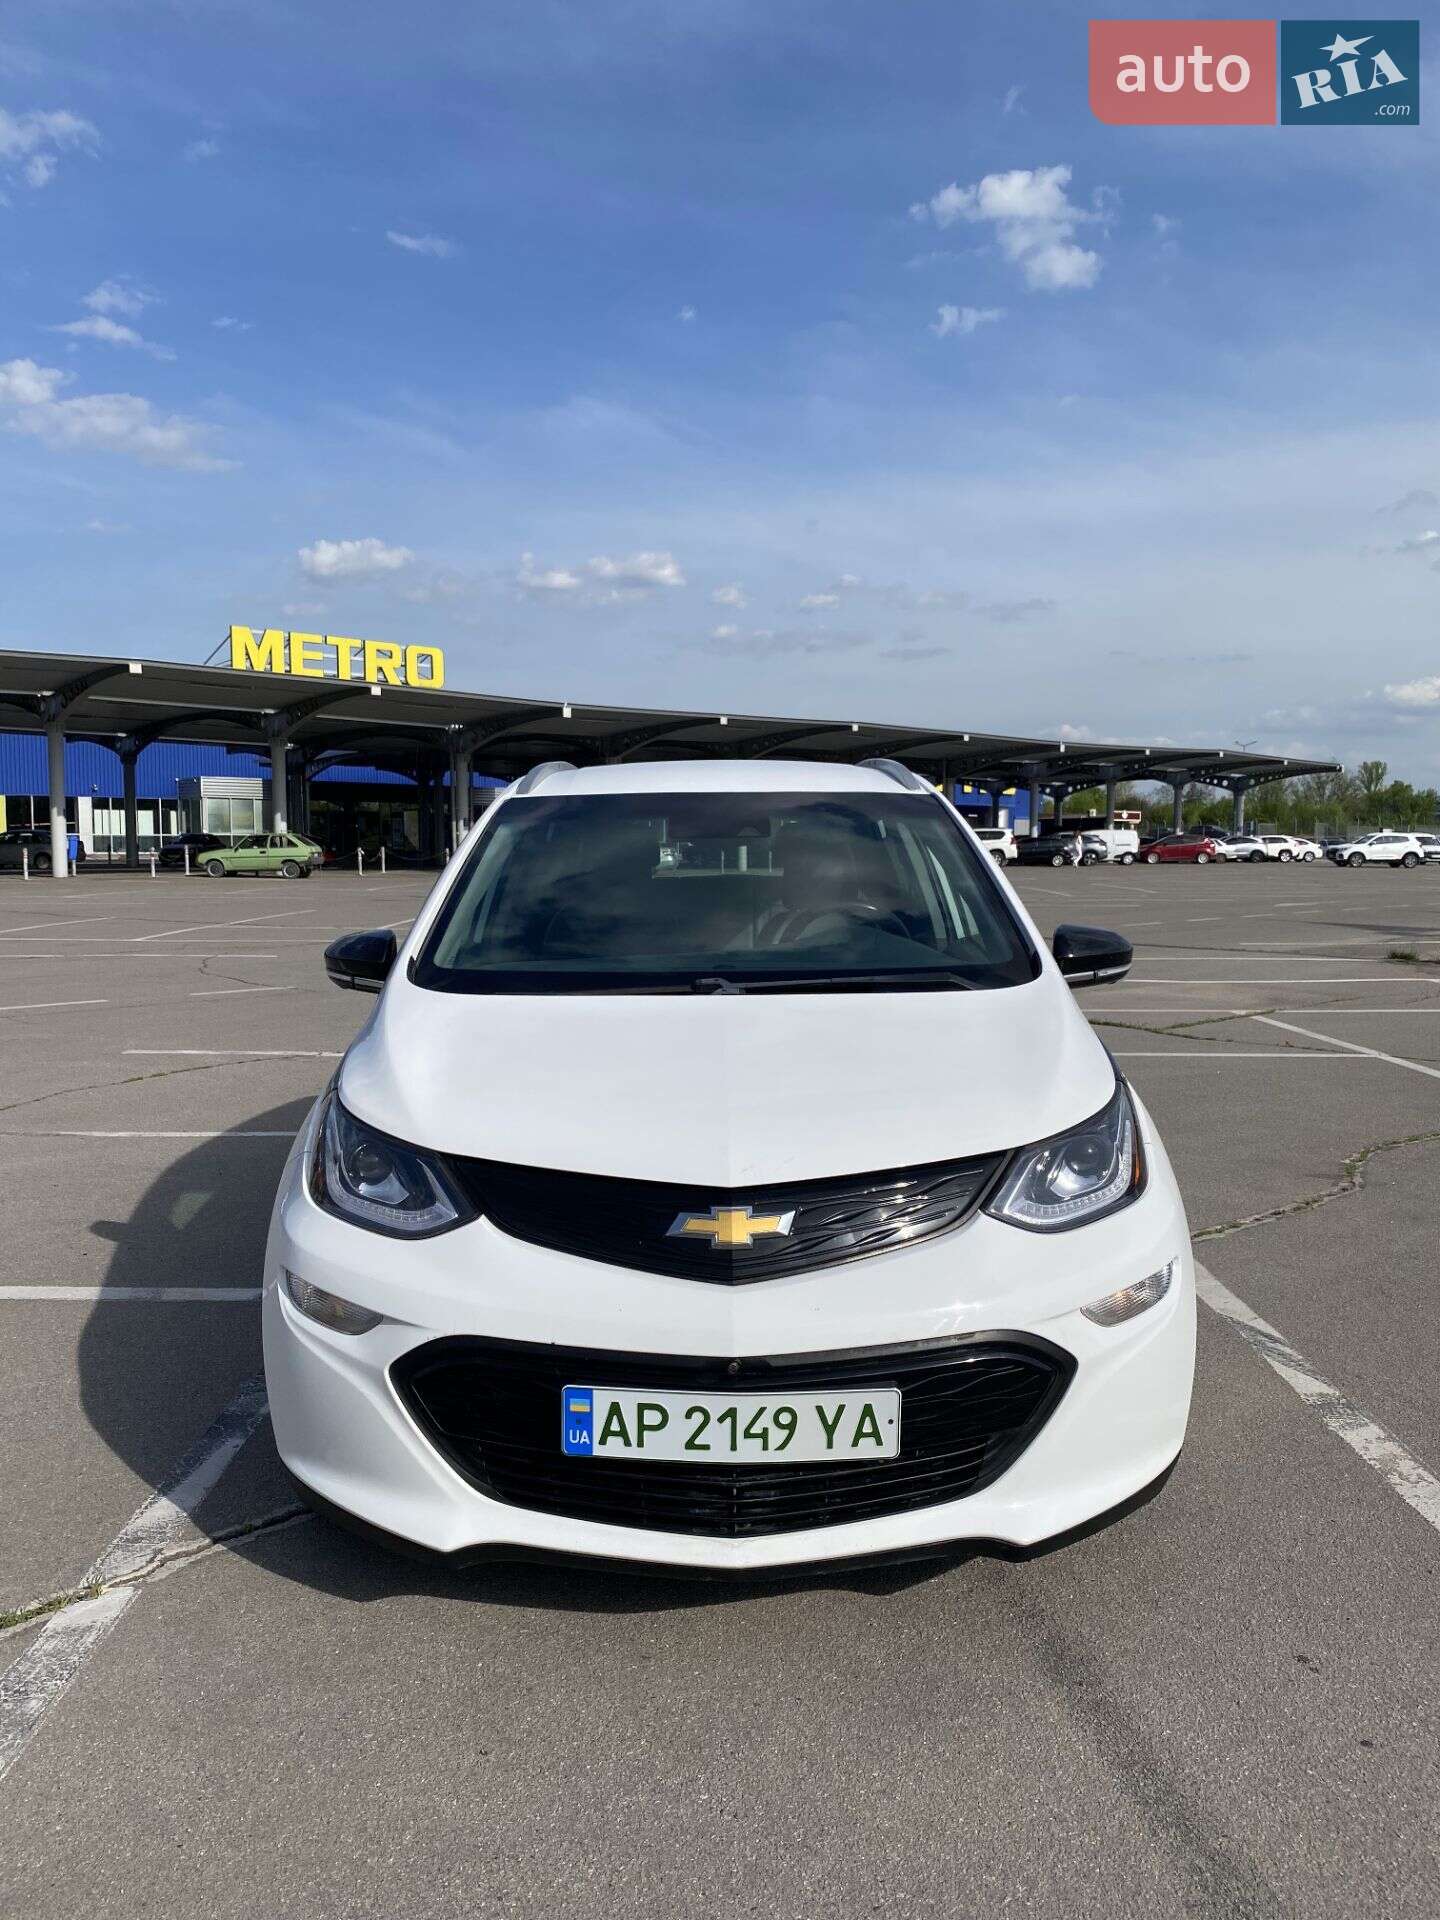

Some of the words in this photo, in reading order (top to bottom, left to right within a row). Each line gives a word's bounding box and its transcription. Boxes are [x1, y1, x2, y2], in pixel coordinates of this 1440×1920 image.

[229, 625, 445, 689] METRO
[569, 1429, 590, 1445] UA
[598, 1401, 670, 1448] AP
[684, 1405, 799, 1451] 2149
[815, 1403, 884, 1449] YA
